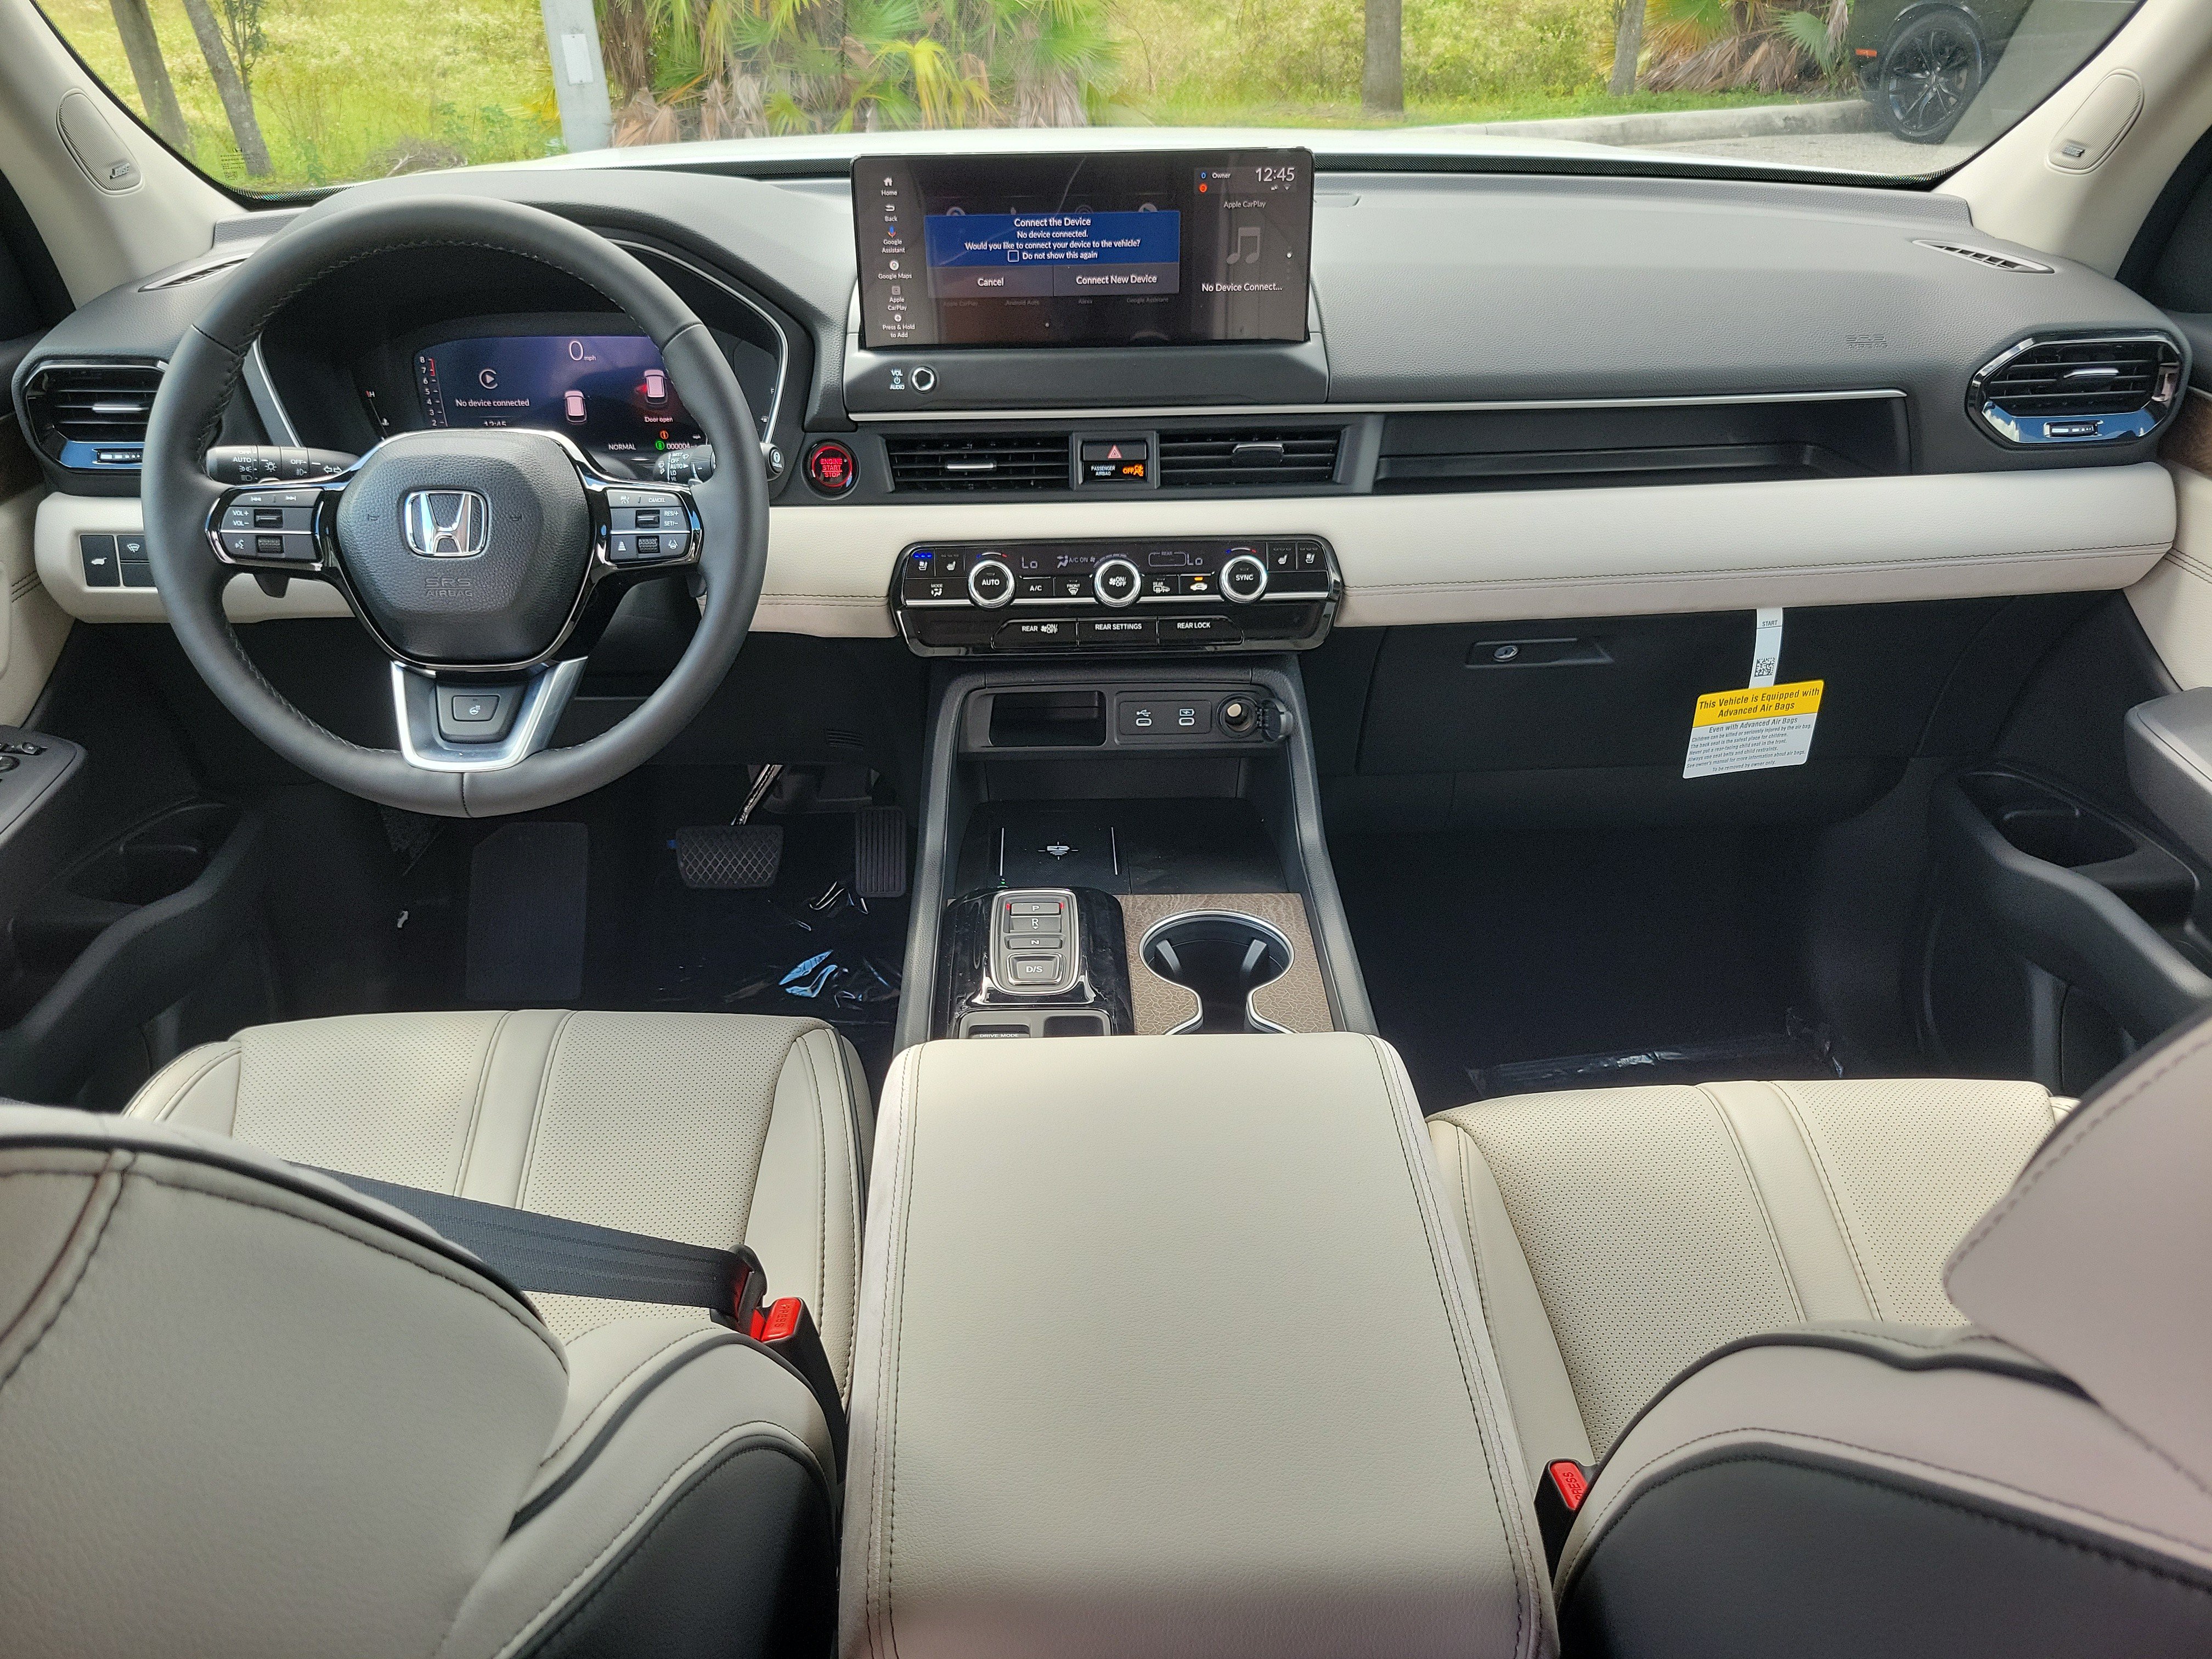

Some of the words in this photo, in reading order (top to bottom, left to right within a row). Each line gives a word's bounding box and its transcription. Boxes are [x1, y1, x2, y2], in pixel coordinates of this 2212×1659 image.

[115, 163, 130, 177] BOSE
[1255, 167, 1295, 182] 12:45
[1223, 201, 1241, 209] Apple
[1242, 200, 1266, 208] CarPlay
[1014, 218, 1048, 227] Connect
[1049, 216, 1062, 227] the
[1064, 216, 1091, 226] Device
[1029, 230, 1051, 238] device
[1052, 230, 1088, 238] connected.
[964, 241, 988, 250] Would
[988, 242, 1002, 251] you
[1003, 241, 1014, 250] like
[1052, 241, 1068, 250] your
[1069, 240, 1091, 248] device
[1101, 239, 1113, 247] the
[1113, 239, 1141, 247] vehicle?
[1047, 251, 1065, 259] show
[1066, 250, 1079, 259] this
[1080, 251, 1098, 259] again
[977, 276, 1004, 286] Cancel
[1076, 275, 1109, 285] Connect
[1110, 274, 1129, 284] New
[1130, 274, 1158, 284] Device
[1201, 283, 1214, 292] No
[1215, 283, 1242, 292] Device
[1243, 283, 1283, 291] Connect...
[569, 341, 584, 361] 0
[455, 399, 467, 407] No
[468, 398, 492, 407] device
[493, 398, 530, 407] connected
[425, 578, 471, 588] SRS
[1699, 699, 1716, 710] This
[1719, 695, 1748, 707] Vehicle
[1751, 694, 1758, 702] is
[1760, 690, 1799, 702] Equipped
[1802, 687, 1820, 697] with
[1718, 705, 1758, 718] Advanced
[1760, 704, 1773, 713] Air
[1775, 702, 1795, 712] Bags
[1739, 719, 1770, 729] Advanced
[1031, 918, 1039, 926] R
